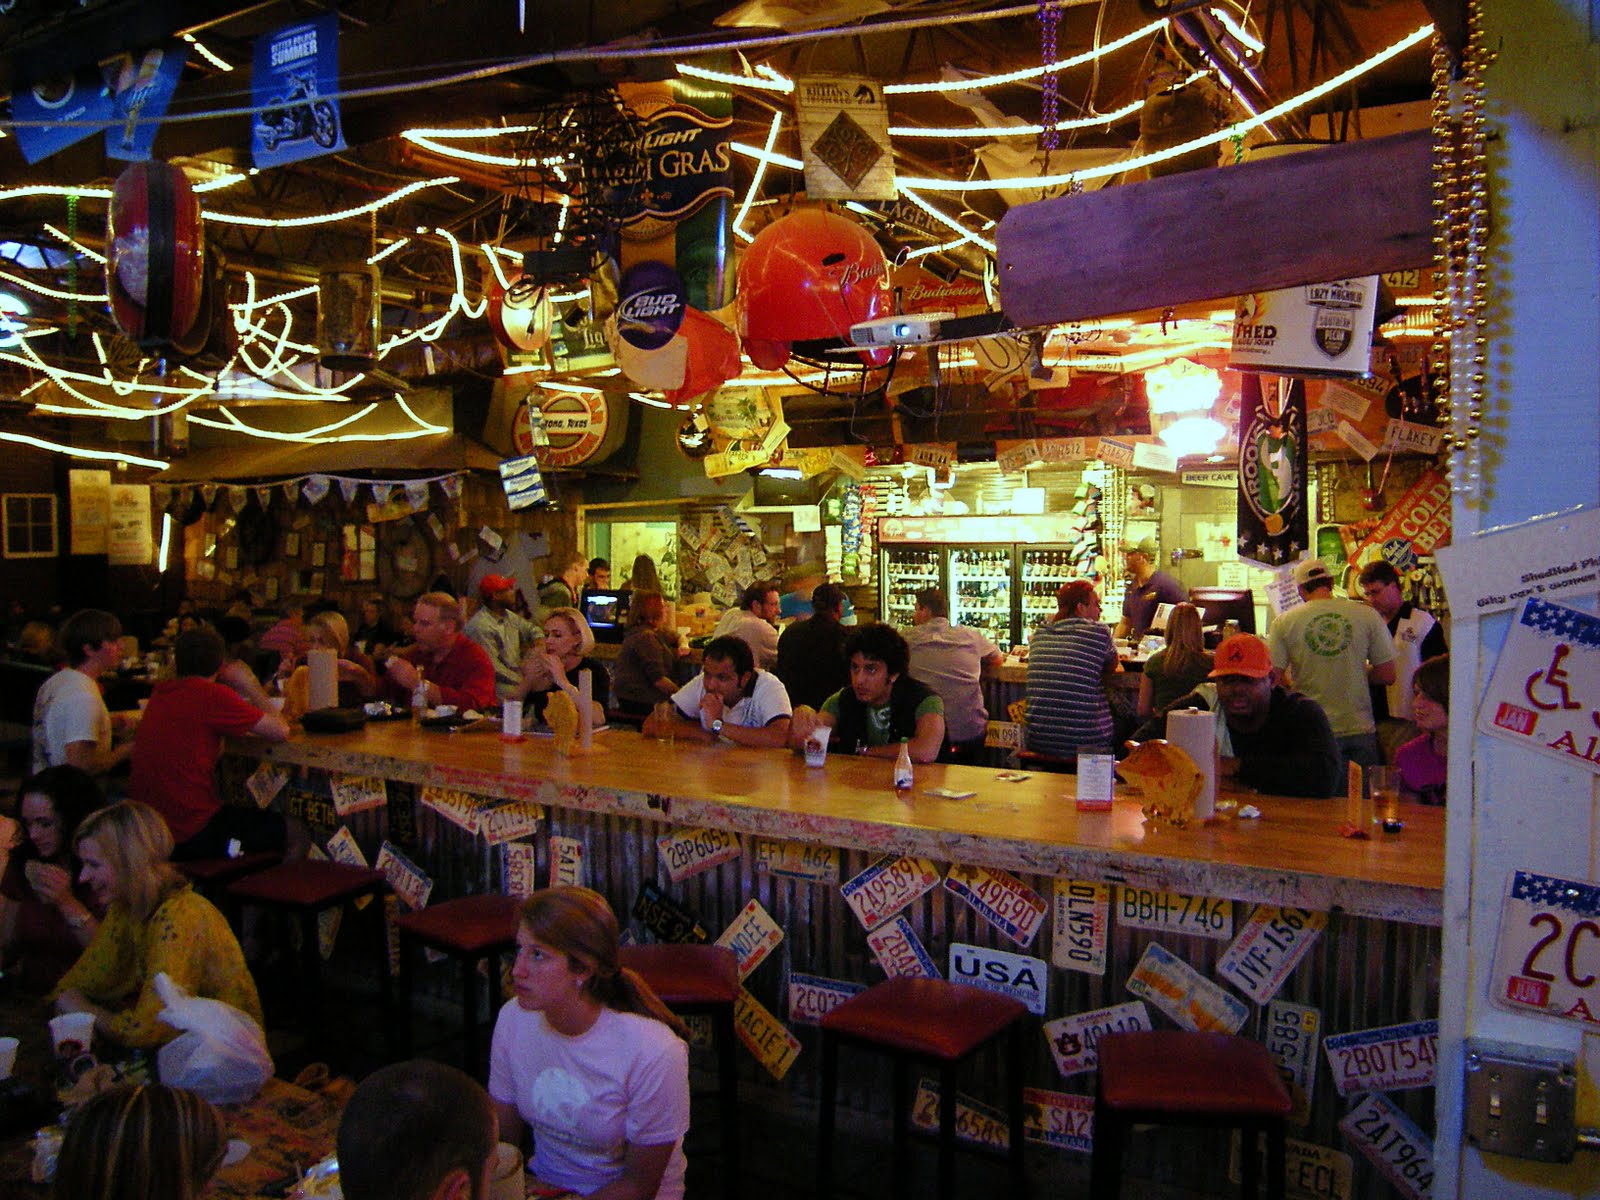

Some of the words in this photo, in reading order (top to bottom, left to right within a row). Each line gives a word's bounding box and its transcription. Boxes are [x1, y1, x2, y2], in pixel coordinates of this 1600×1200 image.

[643, 127, 703, 150] LIGHT
[659, 141, 731, 179] GRAS
[634, 293, 678, 308] BUD
[904, 281, 983, 301] Budweiser
[627, 302, 681, 318] LIGHT
[1390, 425, 1437, 448] FLAKEY
[1185, 474, 1209, 482] BEER
[1211, 473, 1234, 481] CAVE
[1400, 483, 1451, 537] COLD
[1123, 887, 1224, 930] BBH-746
[954, 955, 1039, 991] USA
